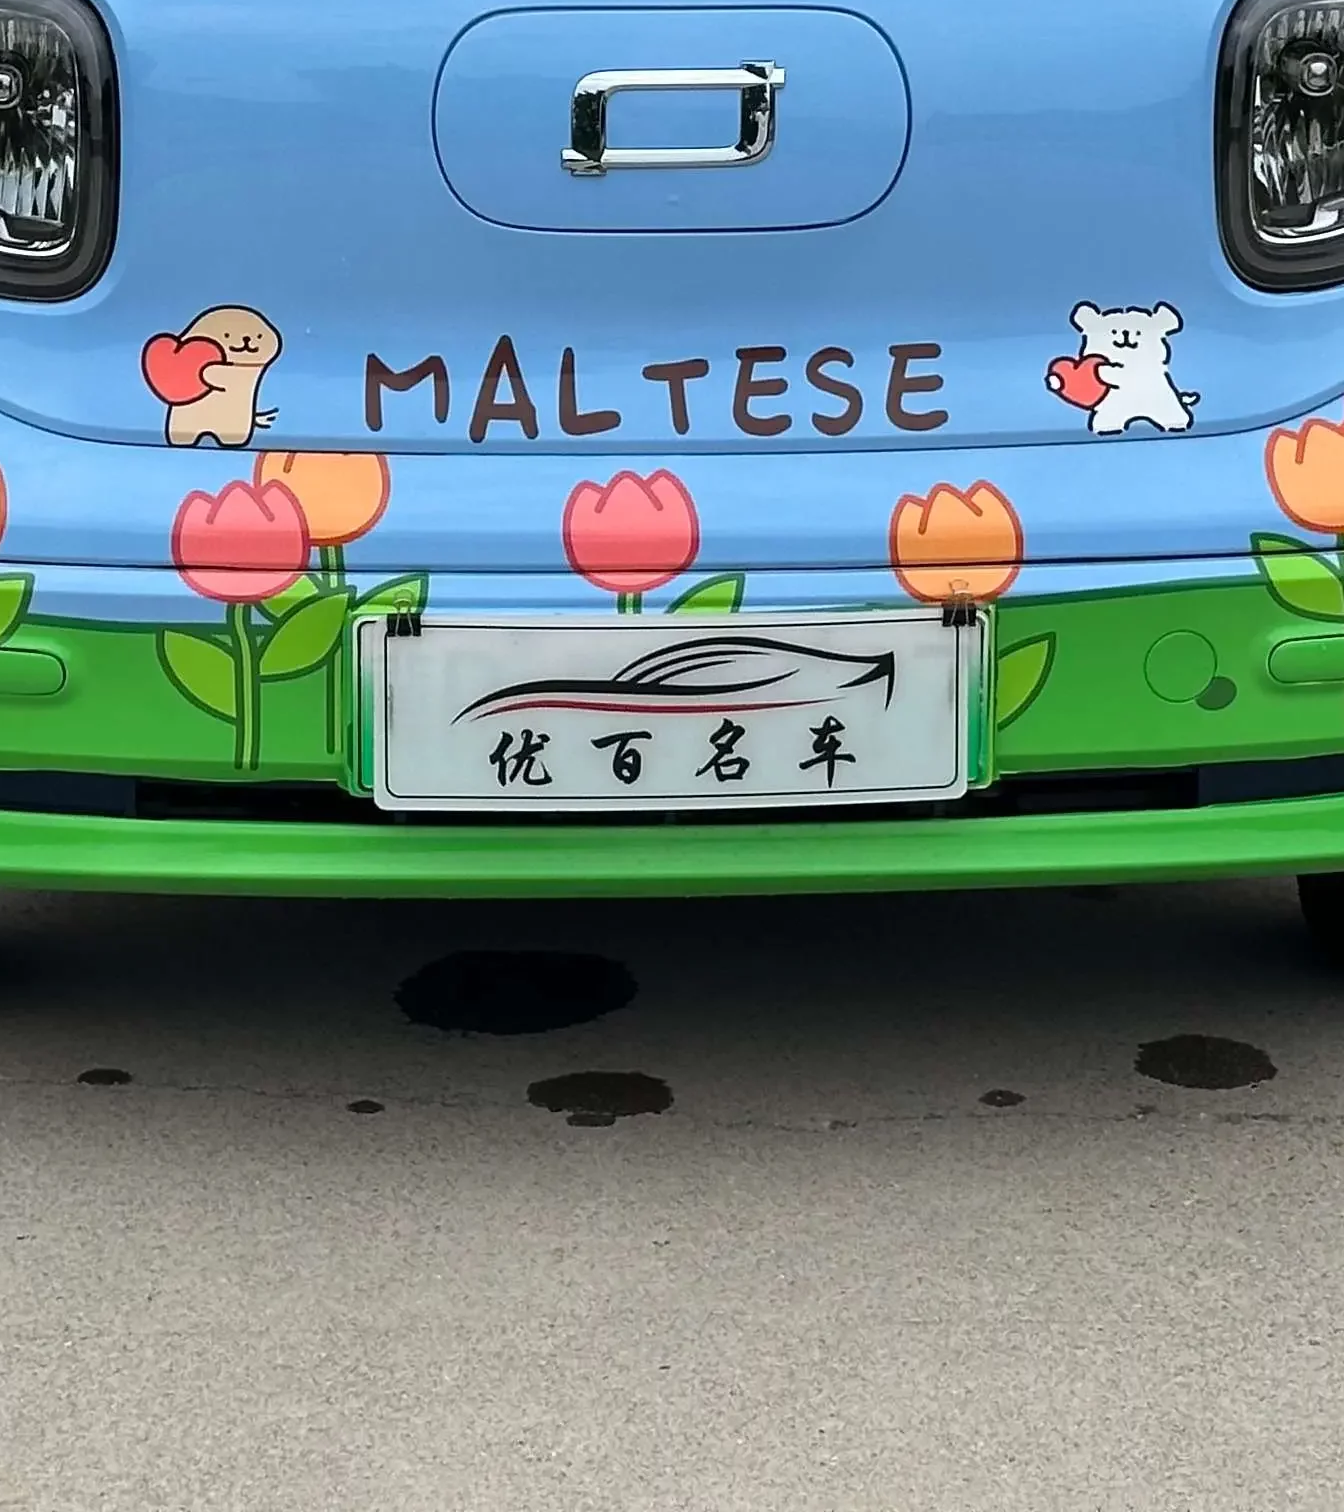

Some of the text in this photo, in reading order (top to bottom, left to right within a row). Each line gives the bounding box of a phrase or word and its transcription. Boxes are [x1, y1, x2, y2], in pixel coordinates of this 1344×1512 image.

[364, 334, 950, 443] MALTESE
[488, 715, 858, 789] 优百名车
